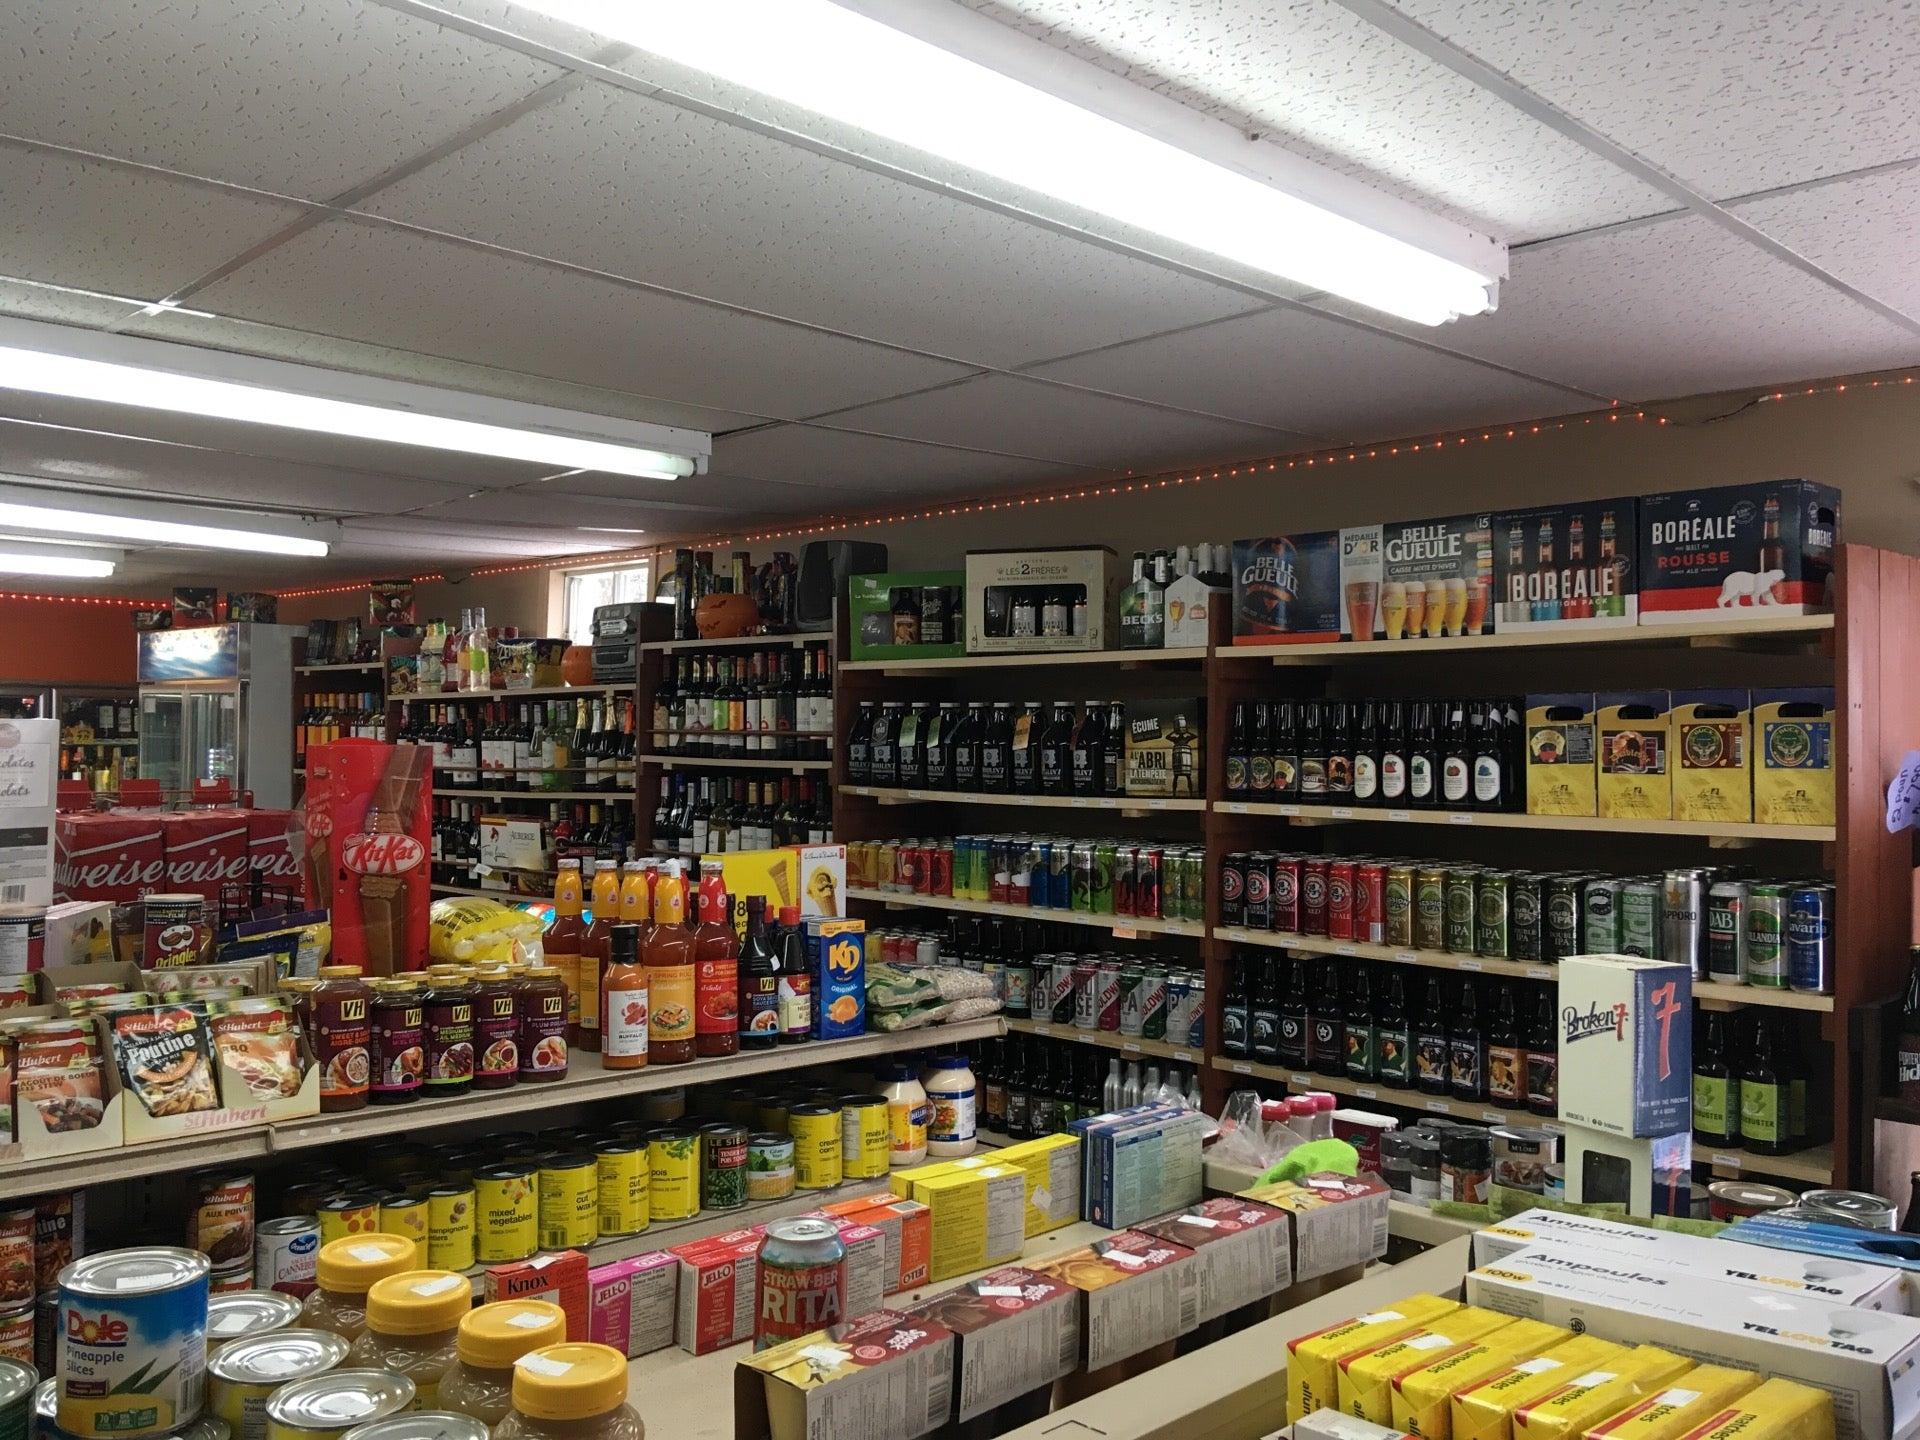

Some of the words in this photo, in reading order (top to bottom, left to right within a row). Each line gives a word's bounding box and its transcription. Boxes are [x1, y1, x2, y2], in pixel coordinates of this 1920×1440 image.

[1478, 517, 1489, 529] 15
[1652, 515, 1736, 545] BORÉALE
[1401, 525, 1447, 543] BELLE
[1385, 534, 1462, 561] GUEULE
[1256, 556, 1295, 573] BELLE
[1657, 551, 1730, 569] ROUSSE
[1005, 568, 1020, 576] LES
[1021, 563, 1030, 575] 2
[1121, 612, 1163, 626] BECK'S
[1132, 718, 1160, 734] ÉCUME
[350, 836, 418, 873] KitKat
[54, 853, 164, 888] udweise
[138, 887, 155, 897] 30
[1709, 911, 1733, 929] DAB
[1788, 921, 1828, 934] avaria
[1450, 925, 1470, 936] IPA
[1481, 928, 1500, 939] IPA
[155, 947, 197, 968] Pringles
[828, 940, 860, 975] KD
[762, 978, 775, 990] VH
[830, 984, 858, 993] ORIGINAL
[343, 1000, 364, 1018] VH
[495, 999, 512, 1014] VH
[545, 998, 561, 1012] VH
[407, 1009, 421, 1025] VH
[454, 1006, 470, 1021] VH
[1562, 1001, 1616, 1037] Broken
[618, 1032, 643, 1040] BUFFALO
[1650, 981, 1682, 1082] 7
[128, 1032, 197, 1065] Poutine
[18, 1054, 62, 1068] tHubert
[710, 1139, 722, 1147] LE
[865, 1136, 884, 1146] grains
[720, 1146, 740, 1157] TENDER
[819, 1146, 835, 1154] corn
[651, 1168, 667, 1177] pois
[628, 1179, 641, 1188] cut
[575, 1194, 589, 1204] cut
[205, 1210, 223, 1218] AUX
[488, 1208, 516, 1217] mixed
[488, 1213, 533, 1227] vegetables
[37, 1217, 66, 1235] tine
[1531, 1214, 1659, 1242] Ampoules
[704, 1265, 731, 1286] JELL-O
[902, 1264, 926, 1284] JELL-O
[1484, 1268, 1525, 1282] 100w
[1524, 1252, 1669, 1286] Ampoules
[508, 1275, 549, 1296] Knox
[597, 1281, 627, 1304] JELL-O
[762, 1285, 840, 1324] RITA
[68, 1309, 129, 1344] Dole
[1742, 1320, 1875, 1355] YELLOWTAG
[66, 1345, 125, 1365] Pineapple
[66, 1359, 95, 1376] Slices
